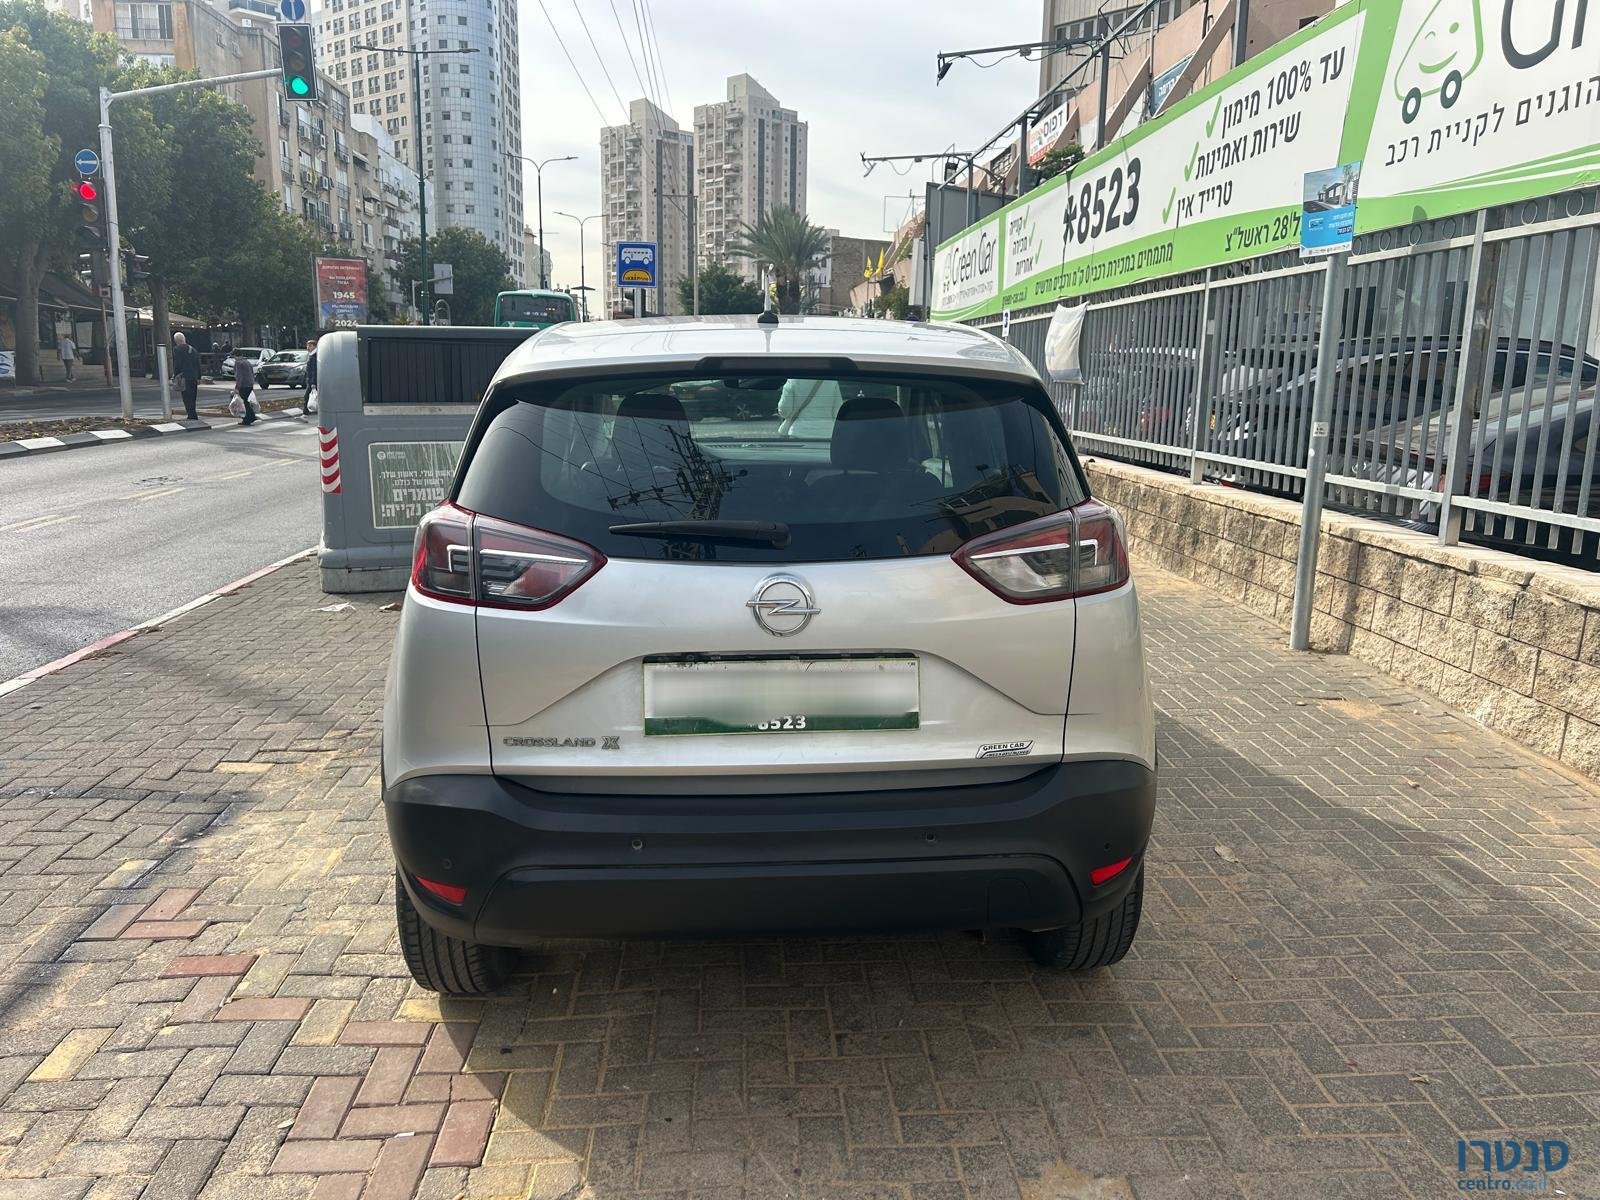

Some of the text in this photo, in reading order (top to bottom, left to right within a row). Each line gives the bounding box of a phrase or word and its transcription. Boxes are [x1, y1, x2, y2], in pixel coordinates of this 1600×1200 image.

[1222, 46, 1346, 139] עד 100% מימון
[1427, 102, 1505, 154] לקניית
[1196, 111, 1301, 180] שירות ואמינות
[1385, 136, 1419, 166] רכב
[1176, 180, 1233, 228] טרייד אין
[1272, 215, 1289, 242] 28
[952, 232, 996, 286] Green Car
[1106, 254, 1135, 278] במכירת
[1137, 242, 1174, 269] מתמחים
[333, 291, 356, 299] 1945
[335, 320, 358, 328] 2024
[502, 736, 620, 750] CROSSLAND X
